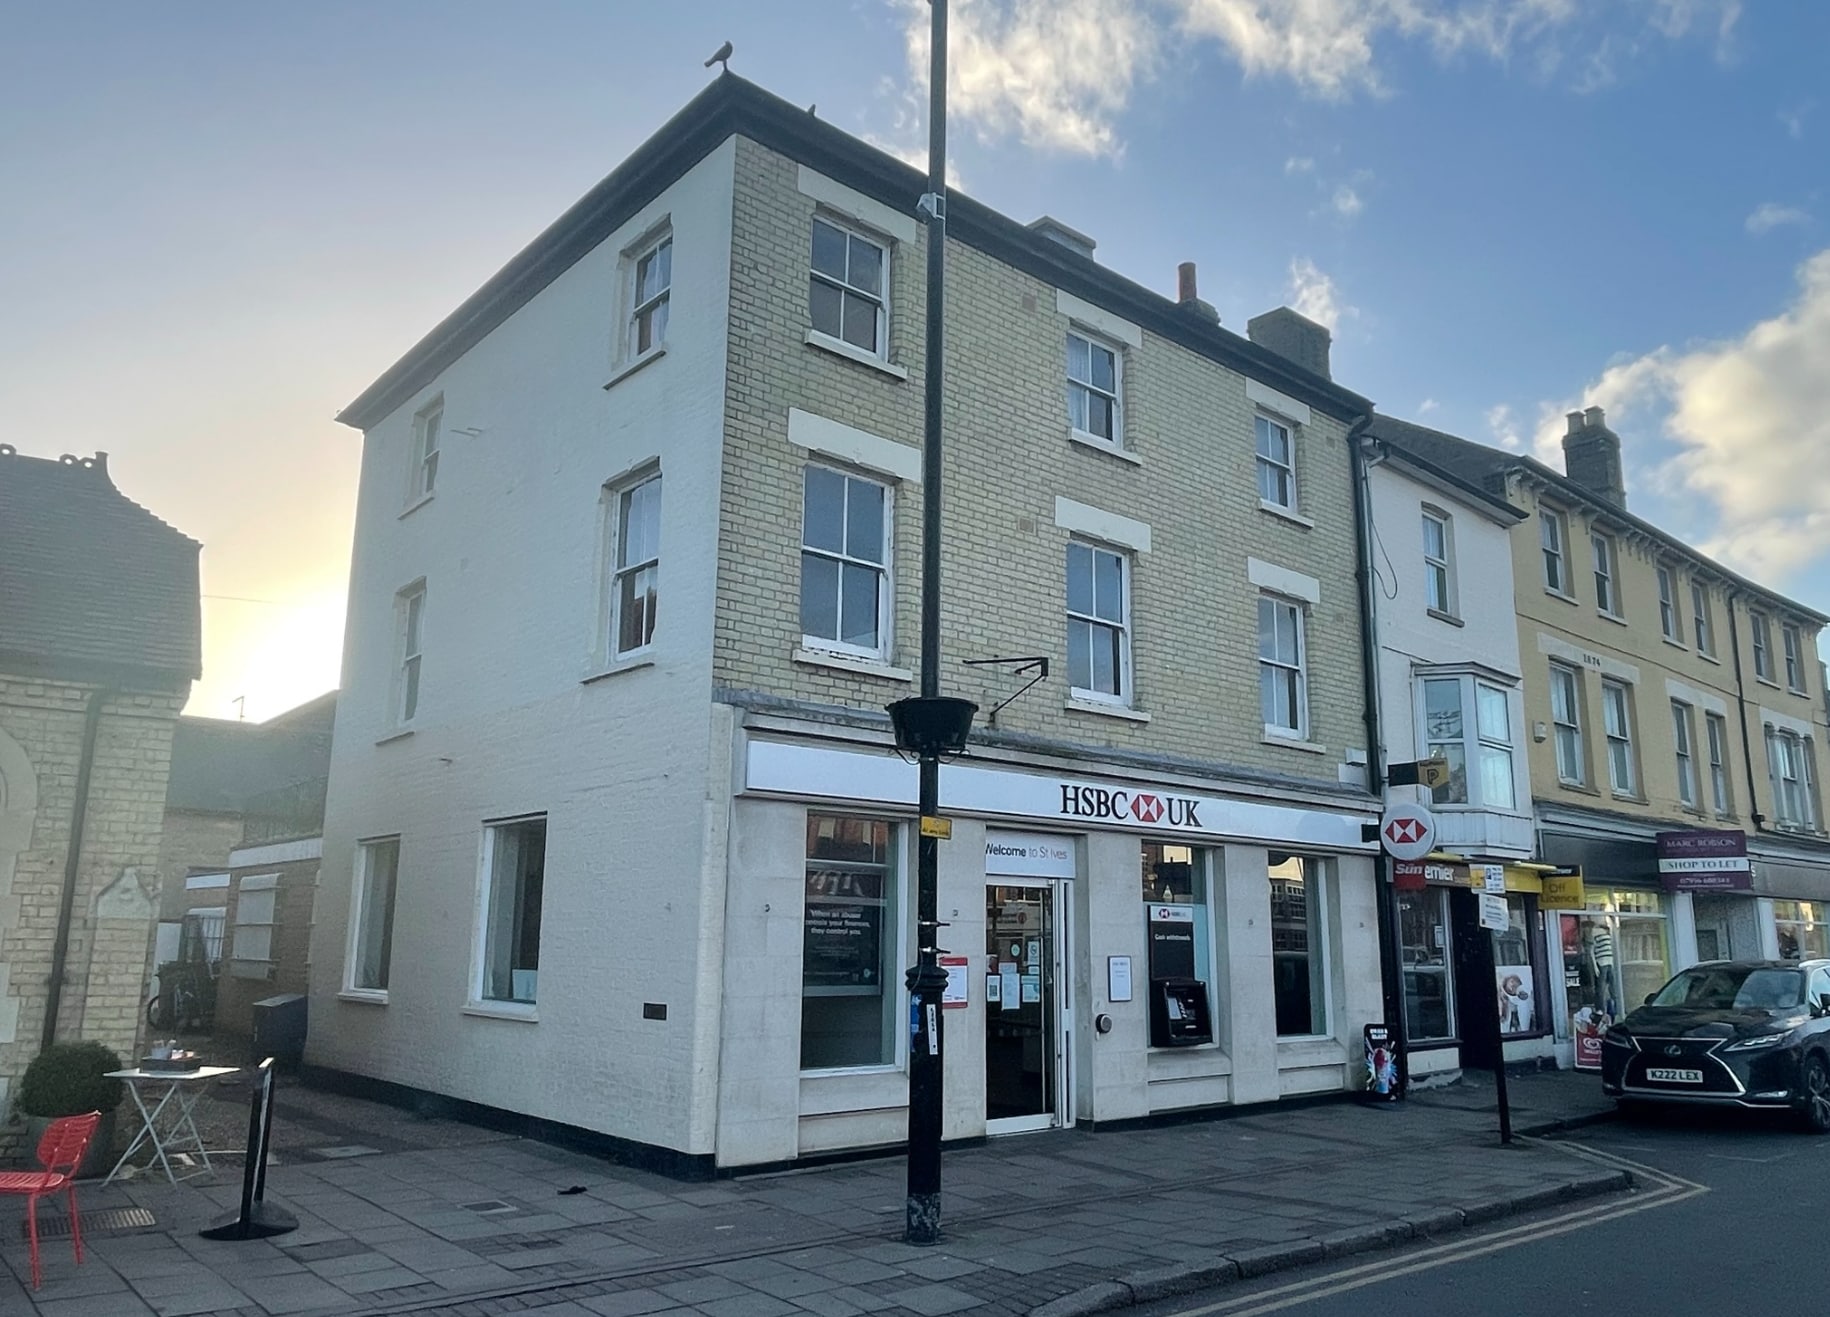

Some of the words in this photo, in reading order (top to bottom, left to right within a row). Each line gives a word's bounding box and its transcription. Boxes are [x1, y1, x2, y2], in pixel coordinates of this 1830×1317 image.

[1060, 784, 1129, 820] HSBC
[1165, 797, 1204, 827] UK
[1666, 840, 1695, 848] MARC
[1697, 838, 1736, 847] ROBSON
[985, 843, 1026, 857] Welcome
[1029, 847, 1038, 858] to
[1040, 846, 1049, 859] St
[1051, 848, 1068, 860] Ives
[1668, 861, 1698, 870] SHOP
[1700, 860, 1717, 869] TO
[1719, 860, 1737, 869] LET
[1549, 882, 1566, 894] Off
[1541, 894, 1580, 904] Licence
[811, 927, 825, 935] they
[1650, 1070, 1677, 1079] K222
[1679, 1072, 1699, 1080] LEX
